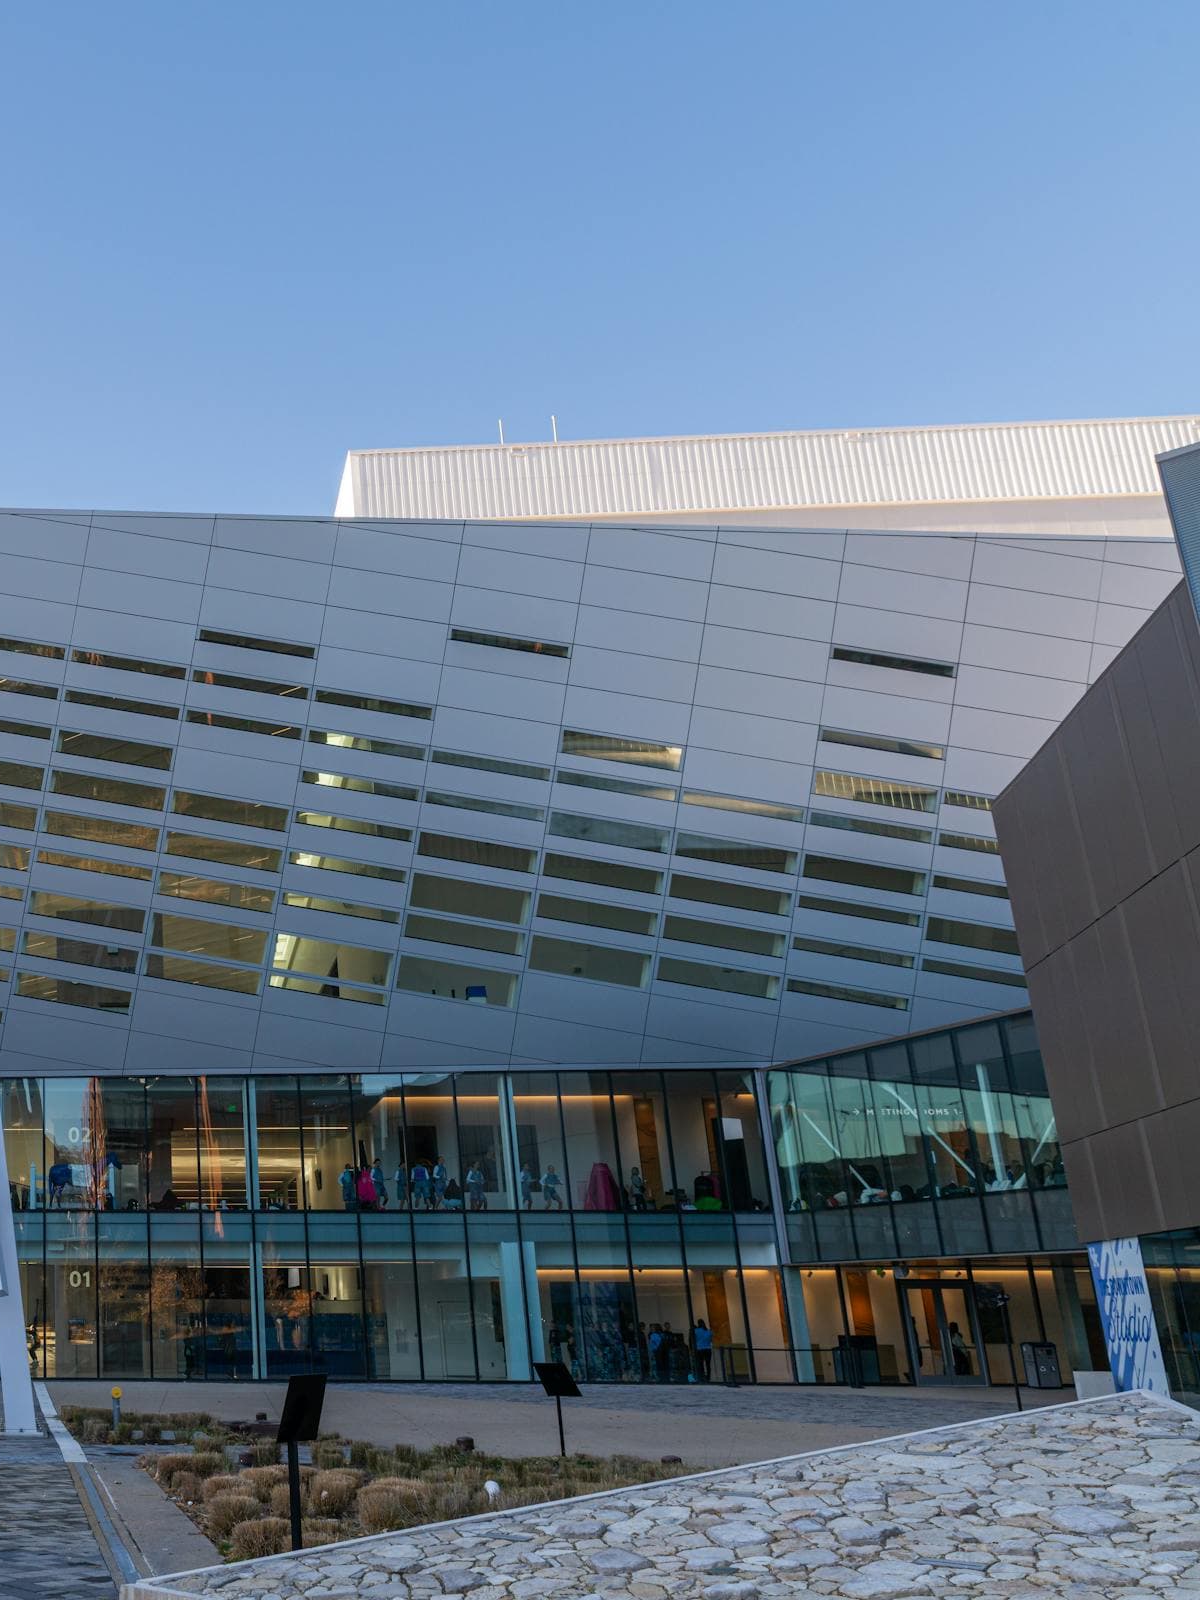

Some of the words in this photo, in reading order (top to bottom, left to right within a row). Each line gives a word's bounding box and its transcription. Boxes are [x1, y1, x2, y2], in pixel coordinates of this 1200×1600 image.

[866, 1108, 911, 1116] METING
[68, 1127, 91, 1143] 02
[69, 1271, 91, 1288] 01
[1108, 1296, 1151, 1341] Studio
